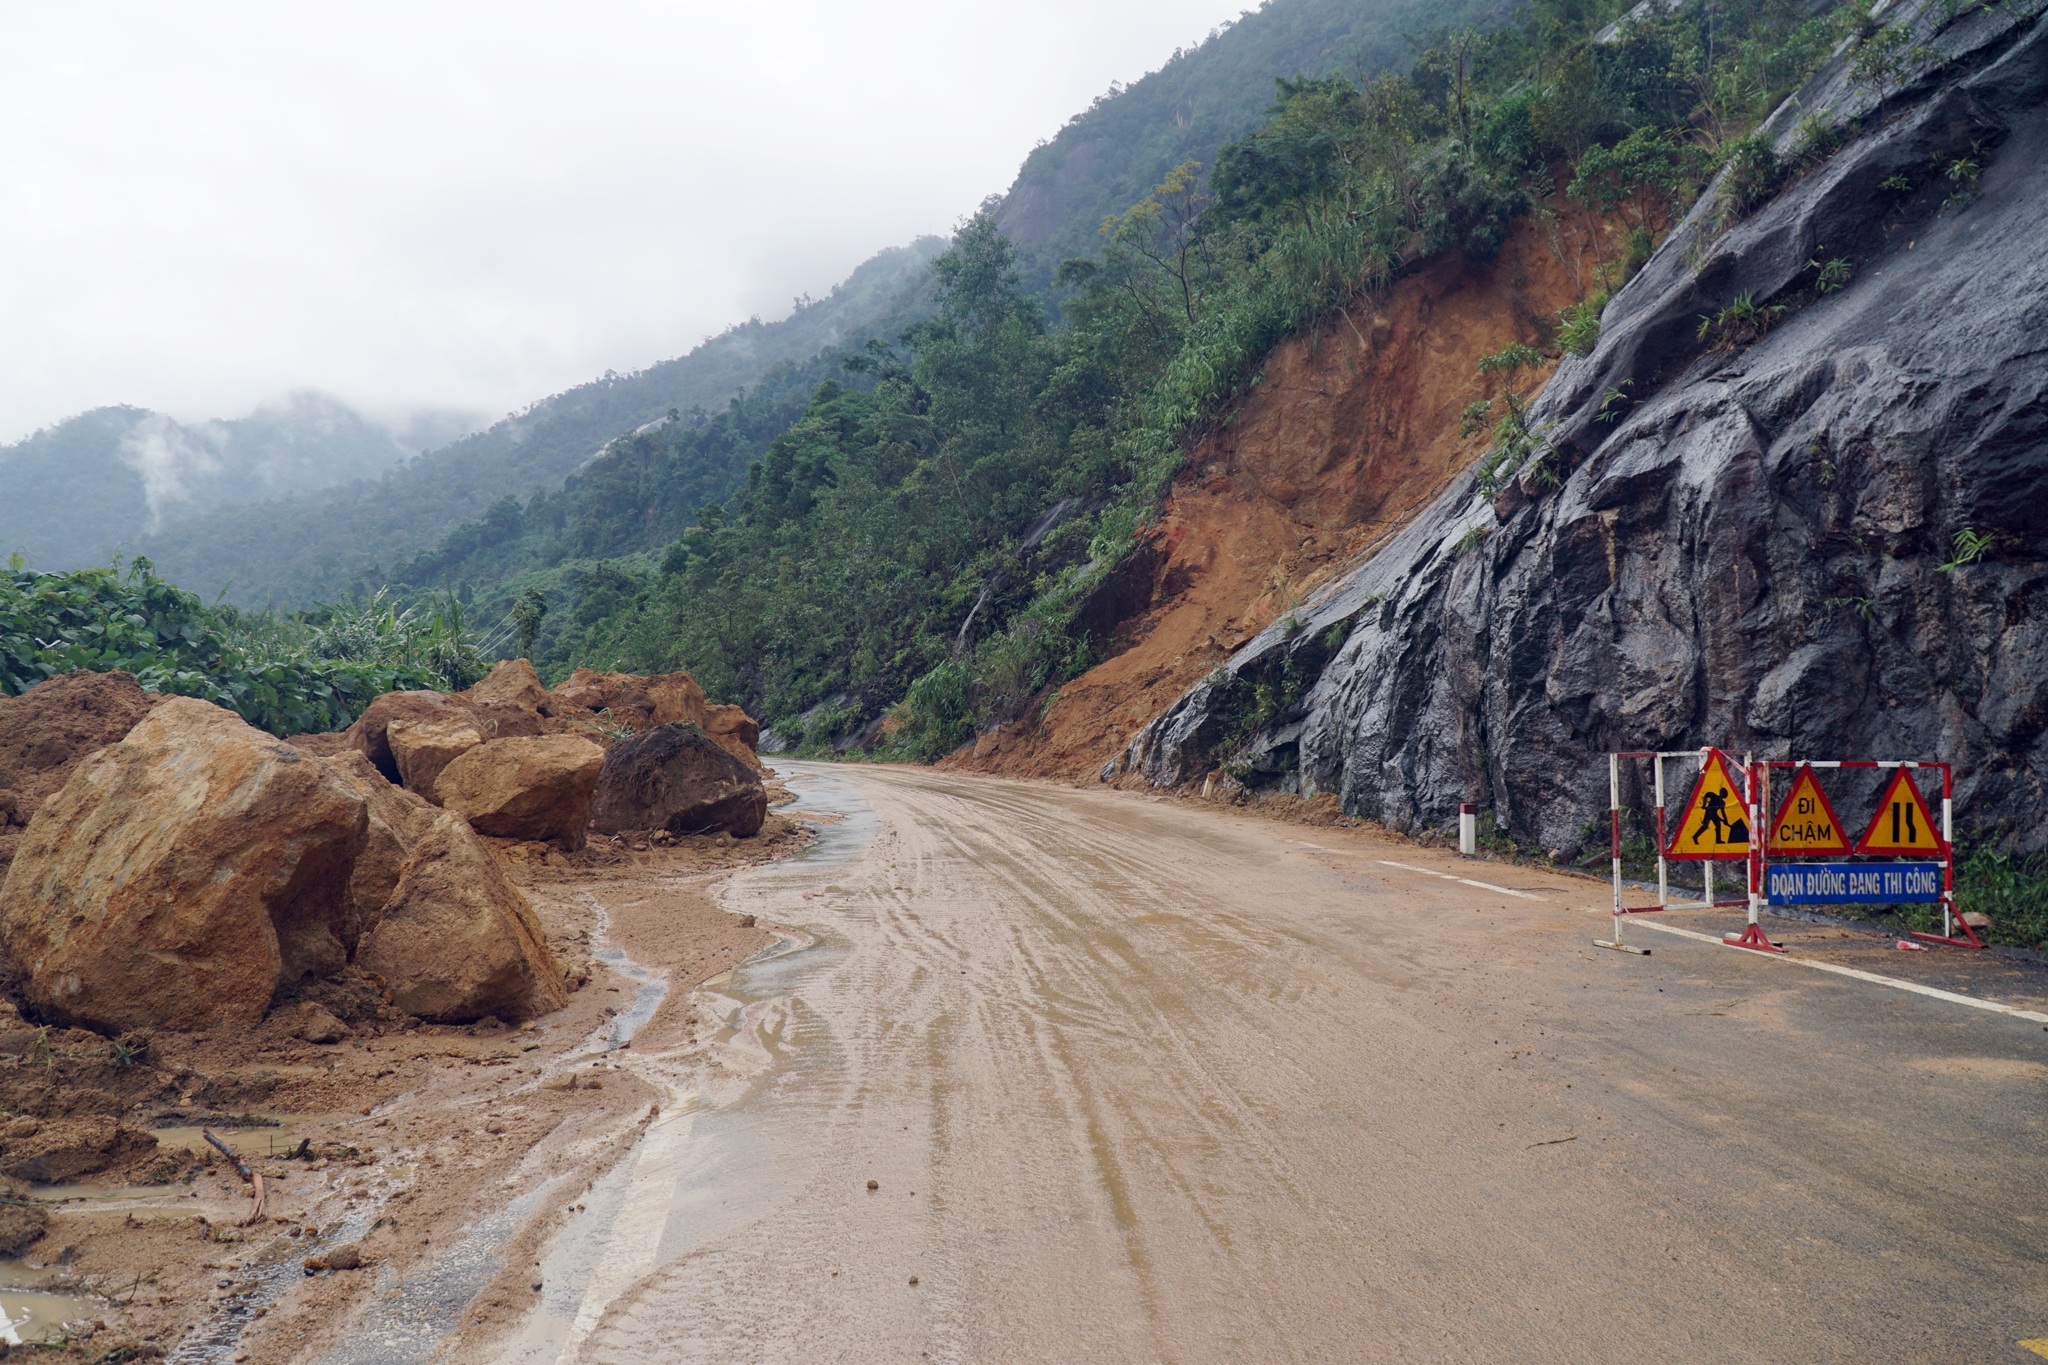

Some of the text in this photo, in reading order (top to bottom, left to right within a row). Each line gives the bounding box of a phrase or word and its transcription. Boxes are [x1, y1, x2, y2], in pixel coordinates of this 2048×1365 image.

[1798, 797, 1815, 814] ĐI
[1780, 820, 1831, 844] CHẬM
[1771, 867, 1936, 900] ĐOẠN ĐƯỜNG ĐANG THI CÔNG
